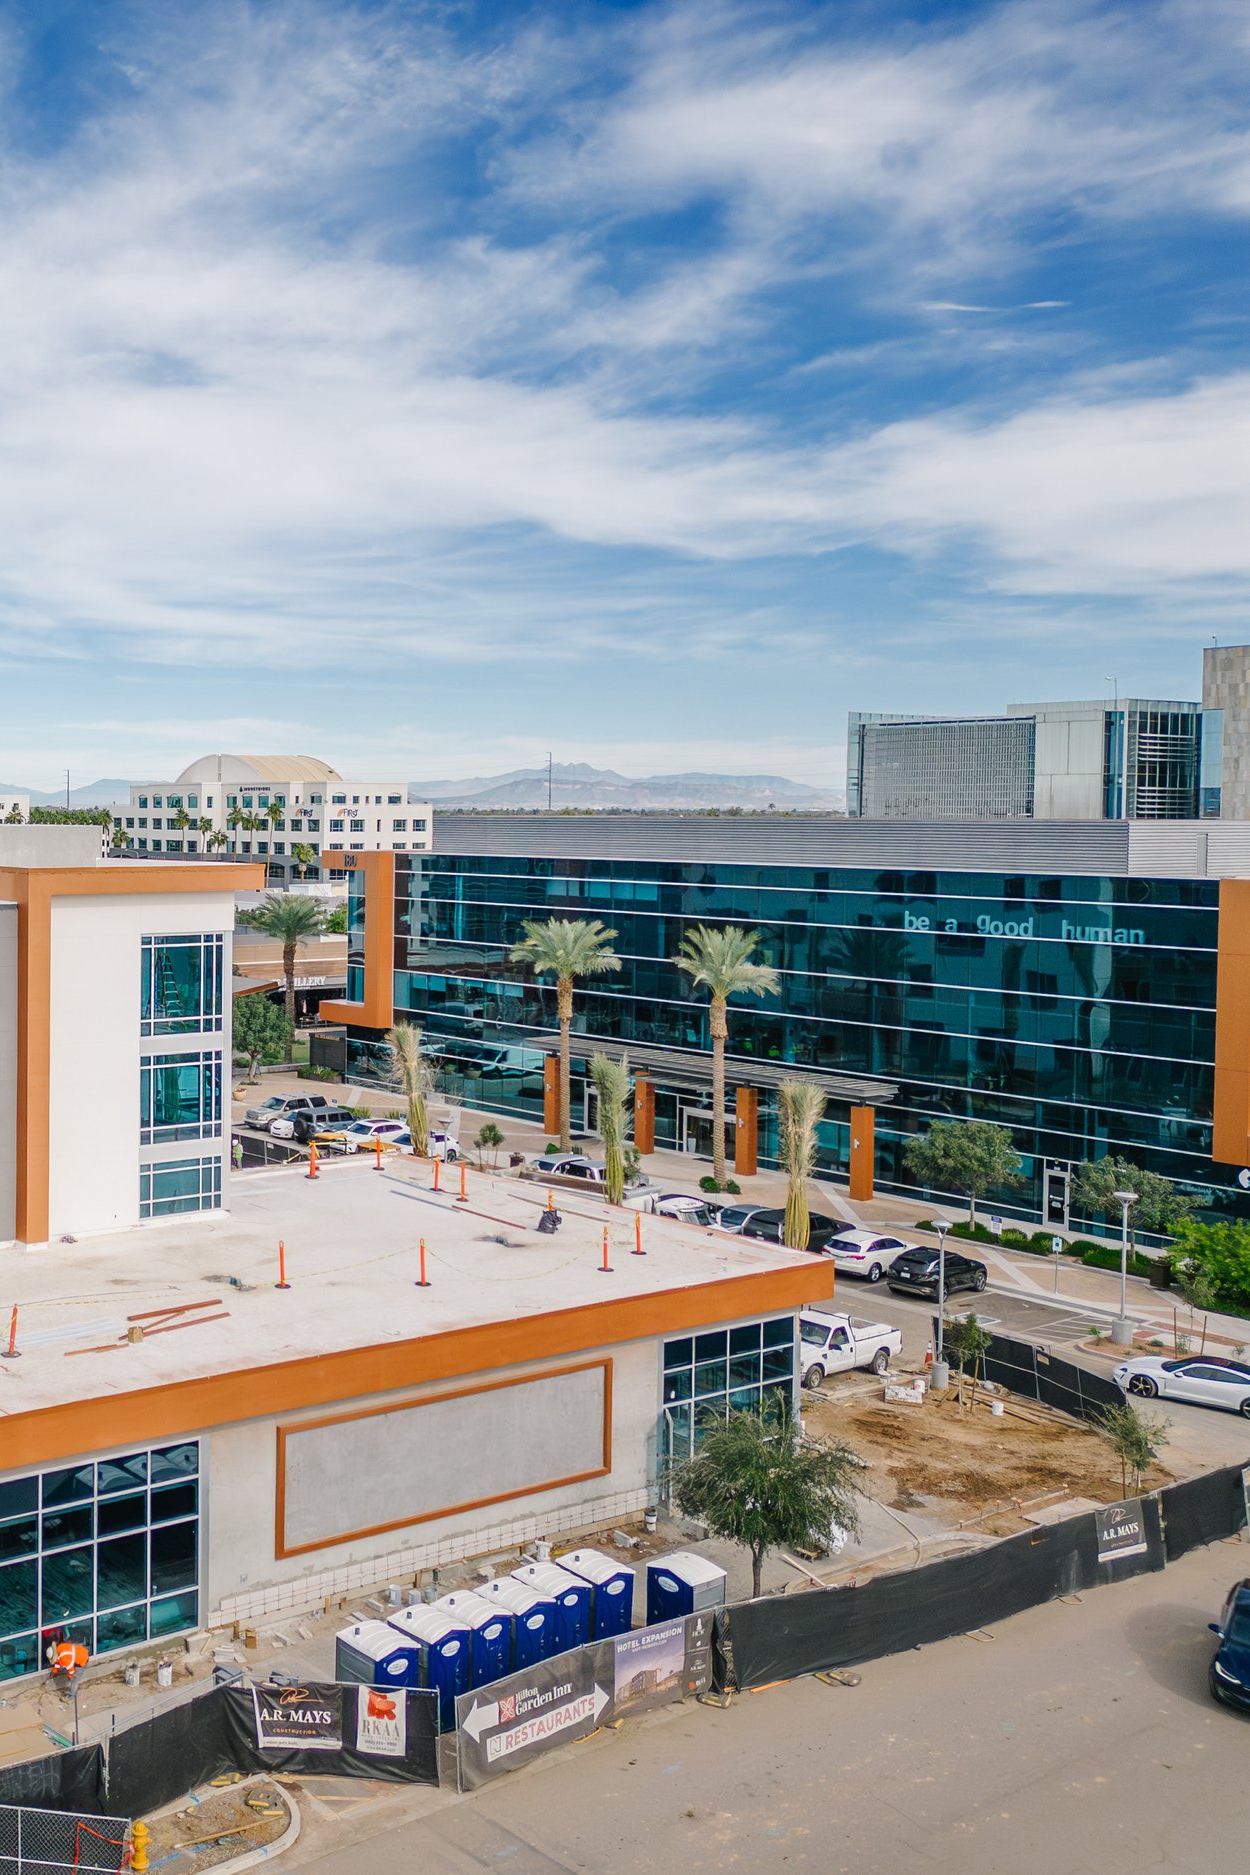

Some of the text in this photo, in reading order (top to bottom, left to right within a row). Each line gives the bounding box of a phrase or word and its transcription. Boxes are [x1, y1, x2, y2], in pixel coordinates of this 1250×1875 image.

[904, 911, 1145, 944] be a good human
[1103, 1522, 1139, 1540] A.R. MAYS
[617, 1639, 640, 1653] HOTEL
[641, 1626, 683, 1645] EXPANSION
[515, 1687, 539, 1703] Hilton
[515, 1682, 572, 1716] Garden Inn
[260, 1708, 331, 1724] A.R. MAYS
[505, 1696, 595, 1750] RESTAURANTS
[362, 1719, 400, 1737] RKAA
